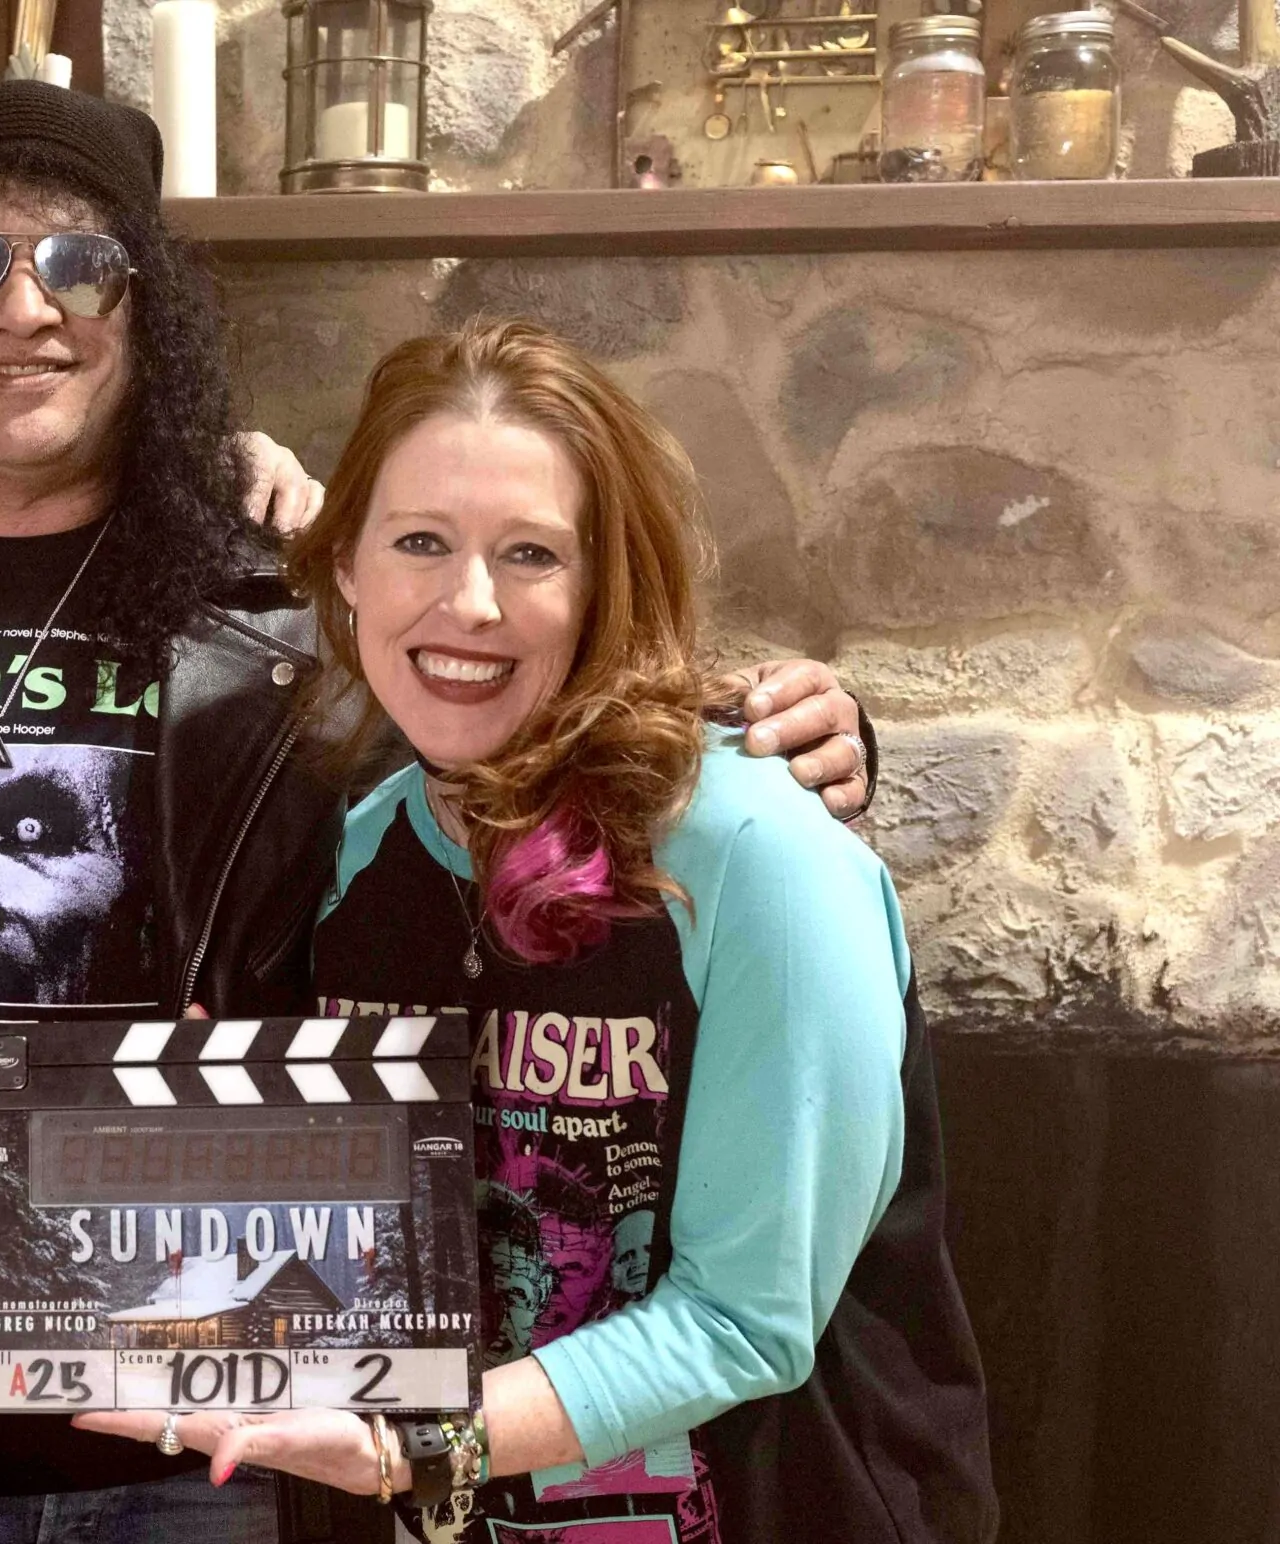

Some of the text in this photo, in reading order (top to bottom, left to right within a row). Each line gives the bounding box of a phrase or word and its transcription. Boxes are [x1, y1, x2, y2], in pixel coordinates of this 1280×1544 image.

[3, 627, 33, 638] novel
[35, 627, 49, 640] by
[50, 627, 91, 642] Stephe
[13, 723, 56, 736] Hooper
[475, 1105, 628, 1142] ur soul apart.
[413, 1142, 464, 1151] HANGAR 18
[605, 1140, 659, 1163] Demon
[606, 1164, 622, 1177] to
[608, 1175, 651, 1201] Angel
[608, 1202, 624, 1215] to
[70, 1206, 376, 1264] SUNDOWN
[354, 1298, 408, 1309] Director
[44, 1316, 96, 1332] NICOD
[292, 1313, 473, 1331] REBEKAH MCKENDRY
[119, 1351, 163, 1364] Scene
[294, 1351, 329, 1364] Take
[350, 1353, 402, 1404] 2
